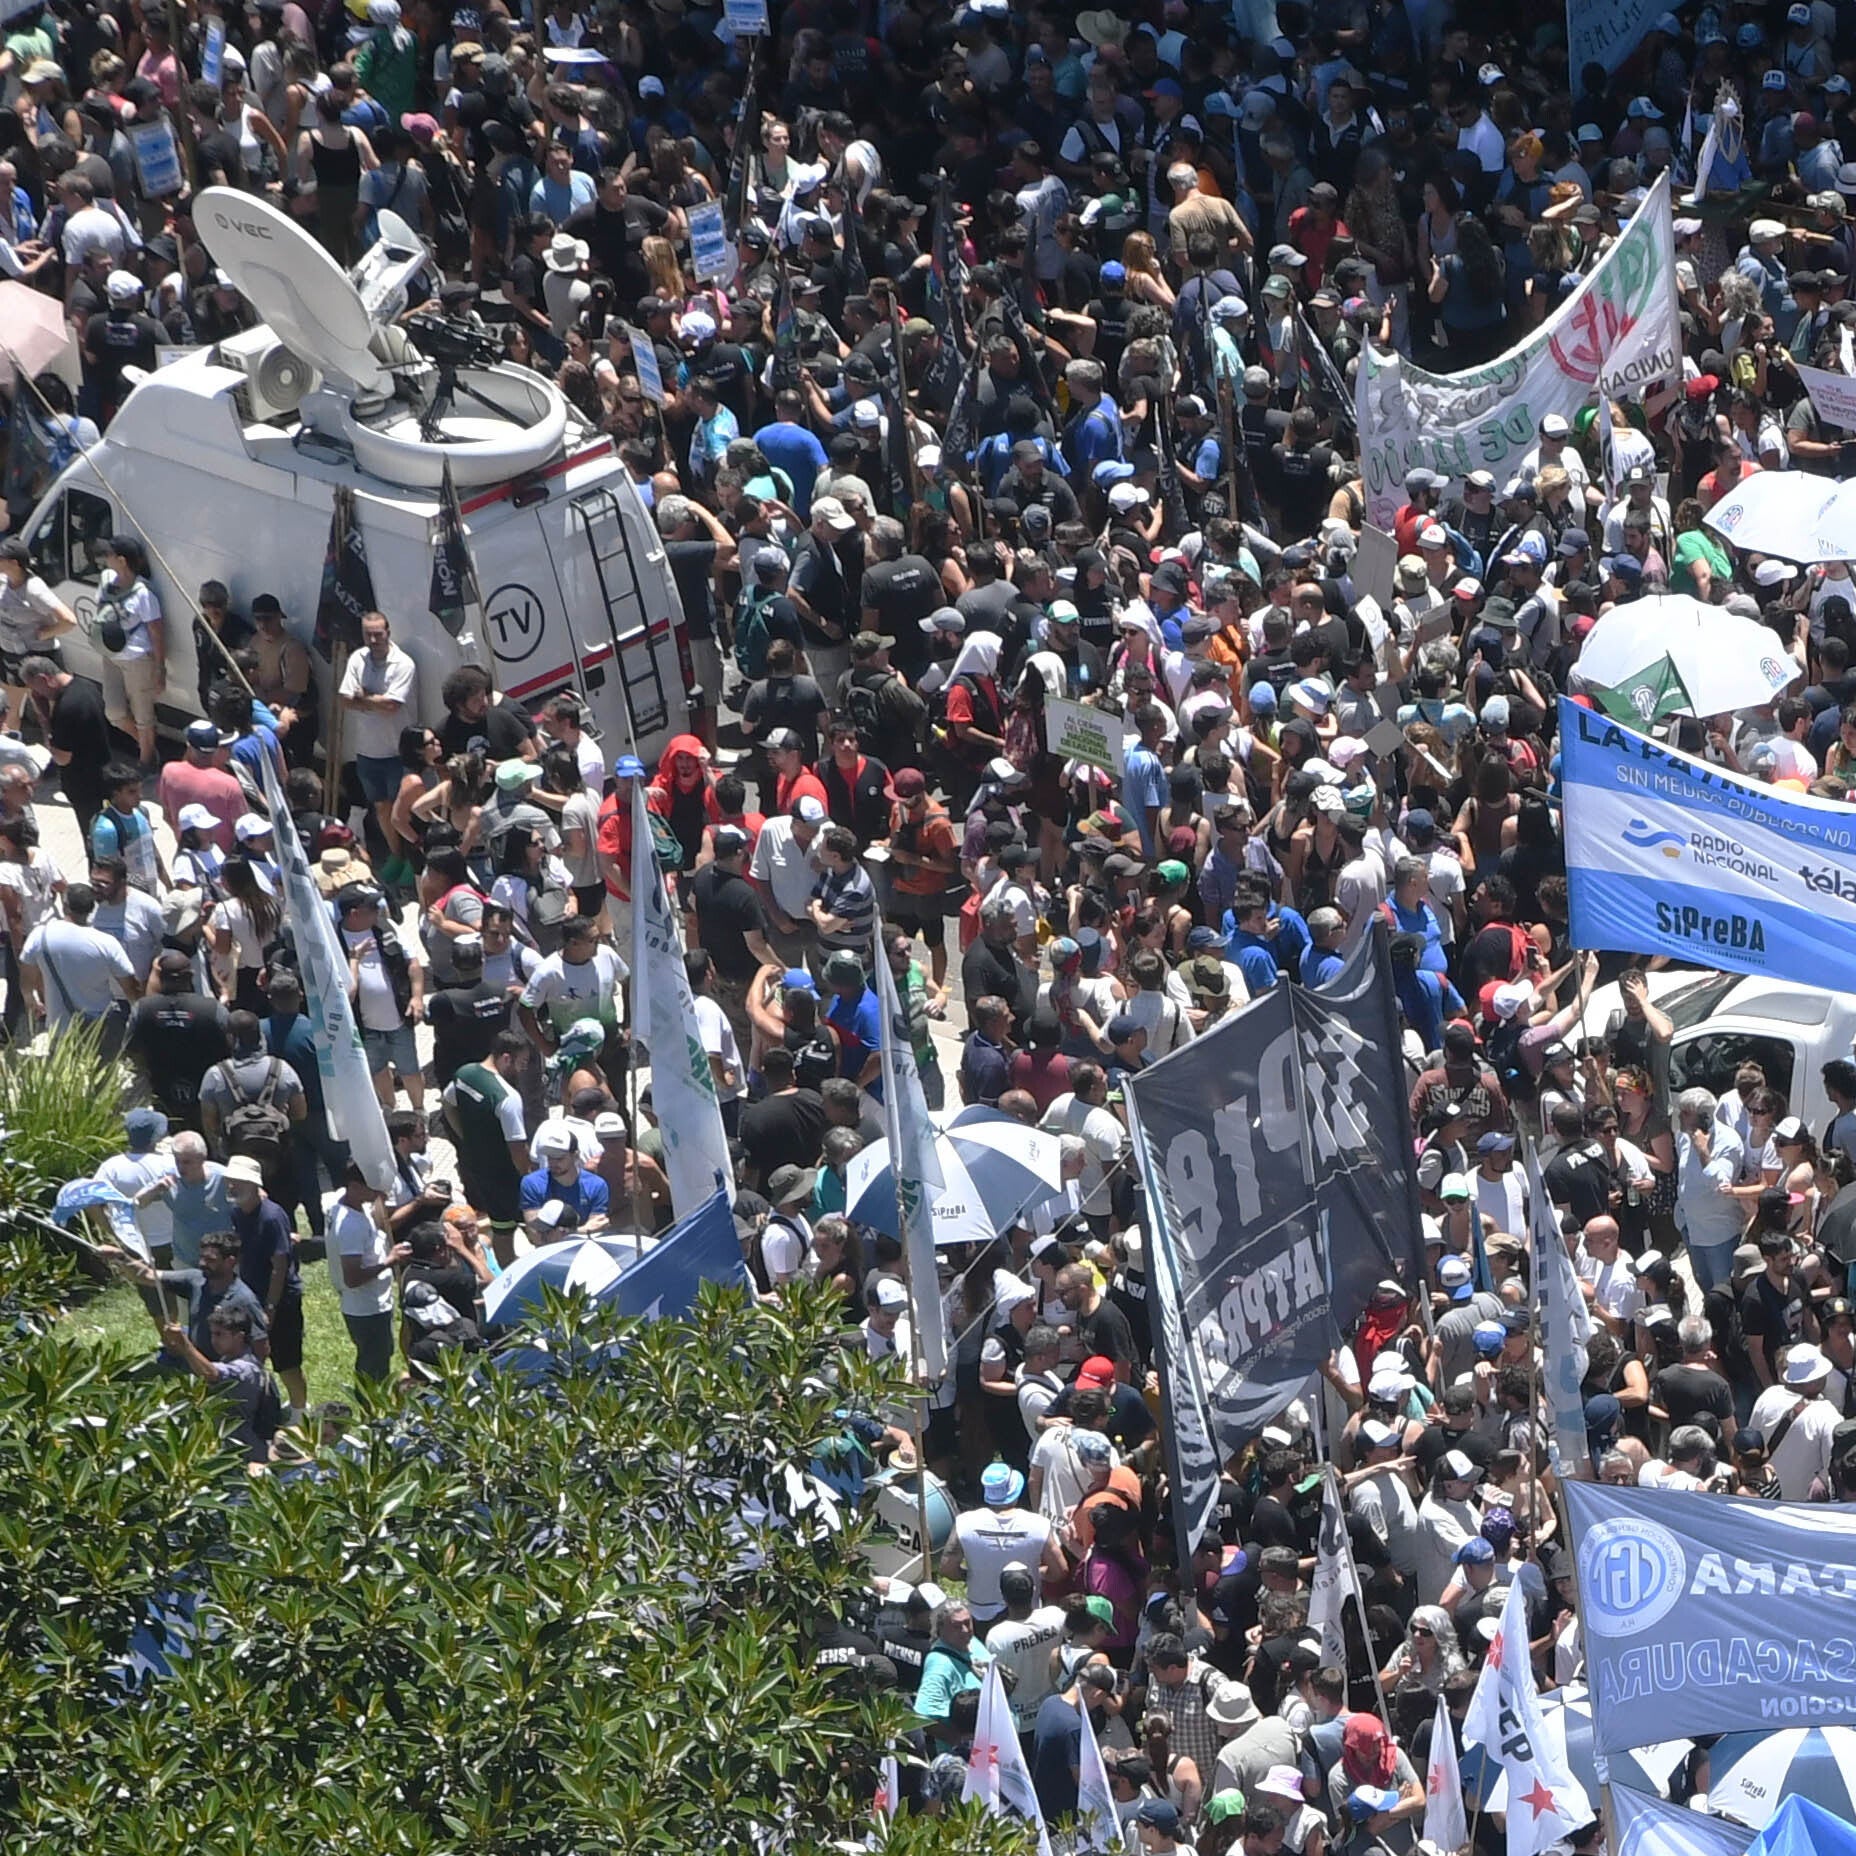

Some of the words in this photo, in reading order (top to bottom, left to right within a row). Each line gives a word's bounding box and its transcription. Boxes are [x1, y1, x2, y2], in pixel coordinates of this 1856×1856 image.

[490, 600, 531, 643] TV
[1578, 711, 1630, 753] LA
[1616, 764, 1648, 787] SIN
[1824, 828, 1851, 849] NO
[1690, 832, 1744, 857] RADIO
[1693, 851, 1779, 882] NACIONAL
[1655, 901, 1765, 953] SiPreBA
[1012, 1625, 1058, 1654] PRENSA
